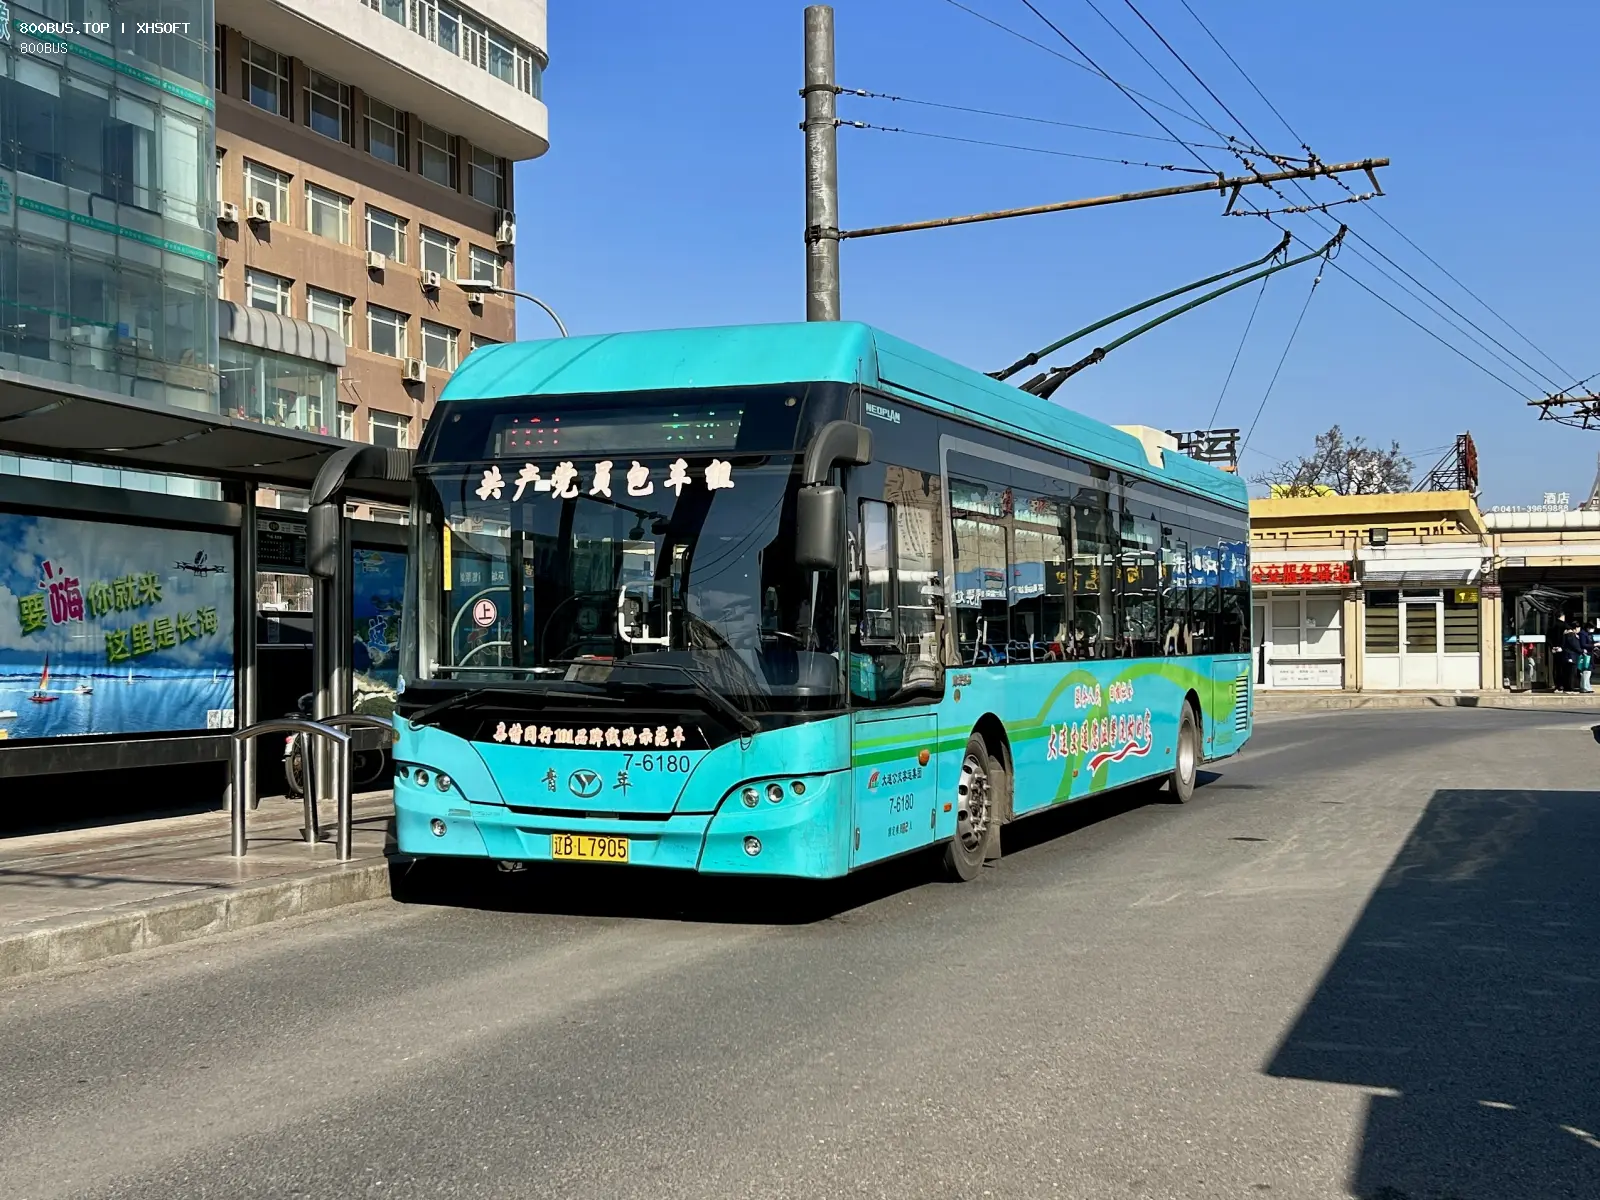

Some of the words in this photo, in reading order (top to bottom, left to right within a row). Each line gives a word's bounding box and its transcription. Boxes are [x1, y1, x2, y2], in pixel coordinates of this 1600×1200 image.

[865, 402, 901, 423] NEOPLAN
[475, 457, 735, 502] 共产党员包车组
[1543, 491, 1570, 505] 酒店
[1251, 561, 1351, 584] 公交服务驿站
[18, 571, 163, 637] 要嗨你就来
[478, 603, 493, 620] 上
[104, 604, 219, 662] 这里是长海
[622, 753, 691, 773] 7-6180
[888, 793, 914, 815] 7-6180
